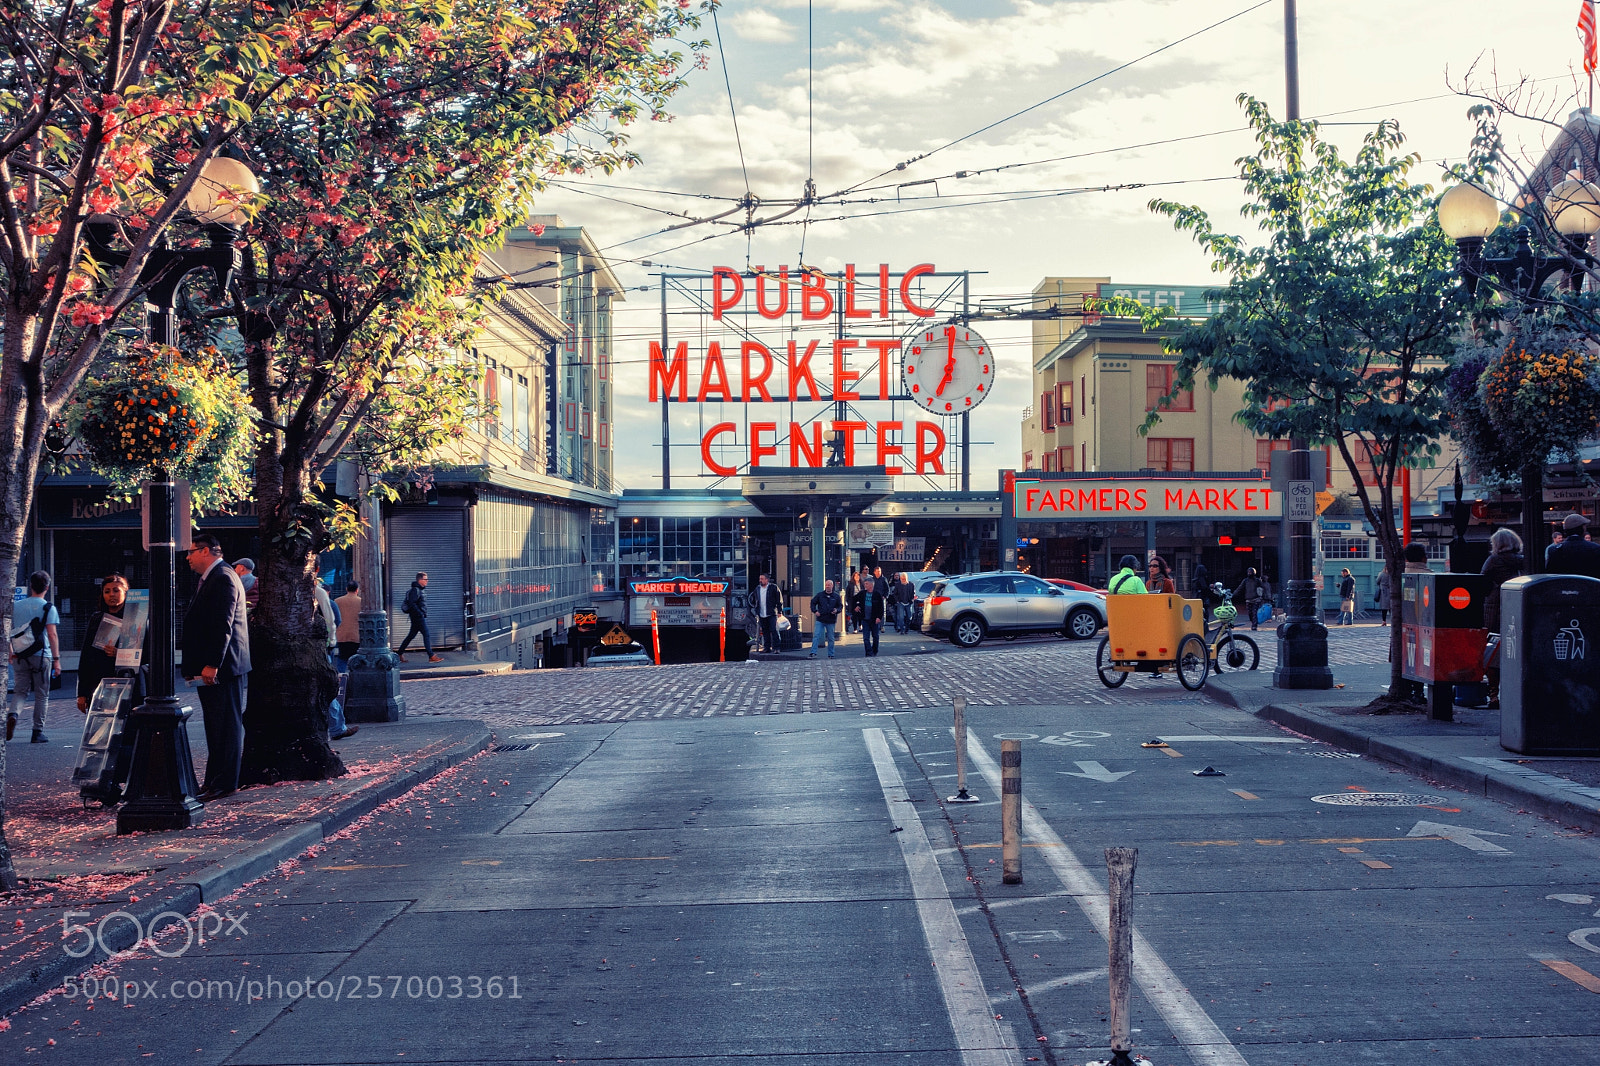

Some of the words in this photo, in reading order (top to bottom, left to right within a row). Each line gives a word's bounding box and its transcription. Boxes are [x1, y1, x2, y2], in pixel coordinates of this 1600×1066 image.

[713, 263, 935, 320] PUBLIC
[926, 332, 933, 342] 11
[965, 332, 969, 341] 1
[912, 346, 921, 355] 10
[978, 346, 984, 355] 2
[648, 339, 901, 402] MARKET
[907, 365, 914, 374] 9
[983, 364, 989, 374] 3
[912, 384, 919, 393] 8
[977, 383, 984, 392] 4
[927, 397, 934, 406] 7
[965, 397, 972, 406] 5
[945, 402, 952, 411] 6
[701, 420, 946, 476] CENTER
[1026, 488, 1147, 511] FARMERS
[1165, 488, 1273, 511] MARKET
[72, 494, 142, 519] Econom
[879, 550, 922, 561] Halibut
[635, 583, 676, 593] MARKET
[679, 583, 724, 593] THEATER
